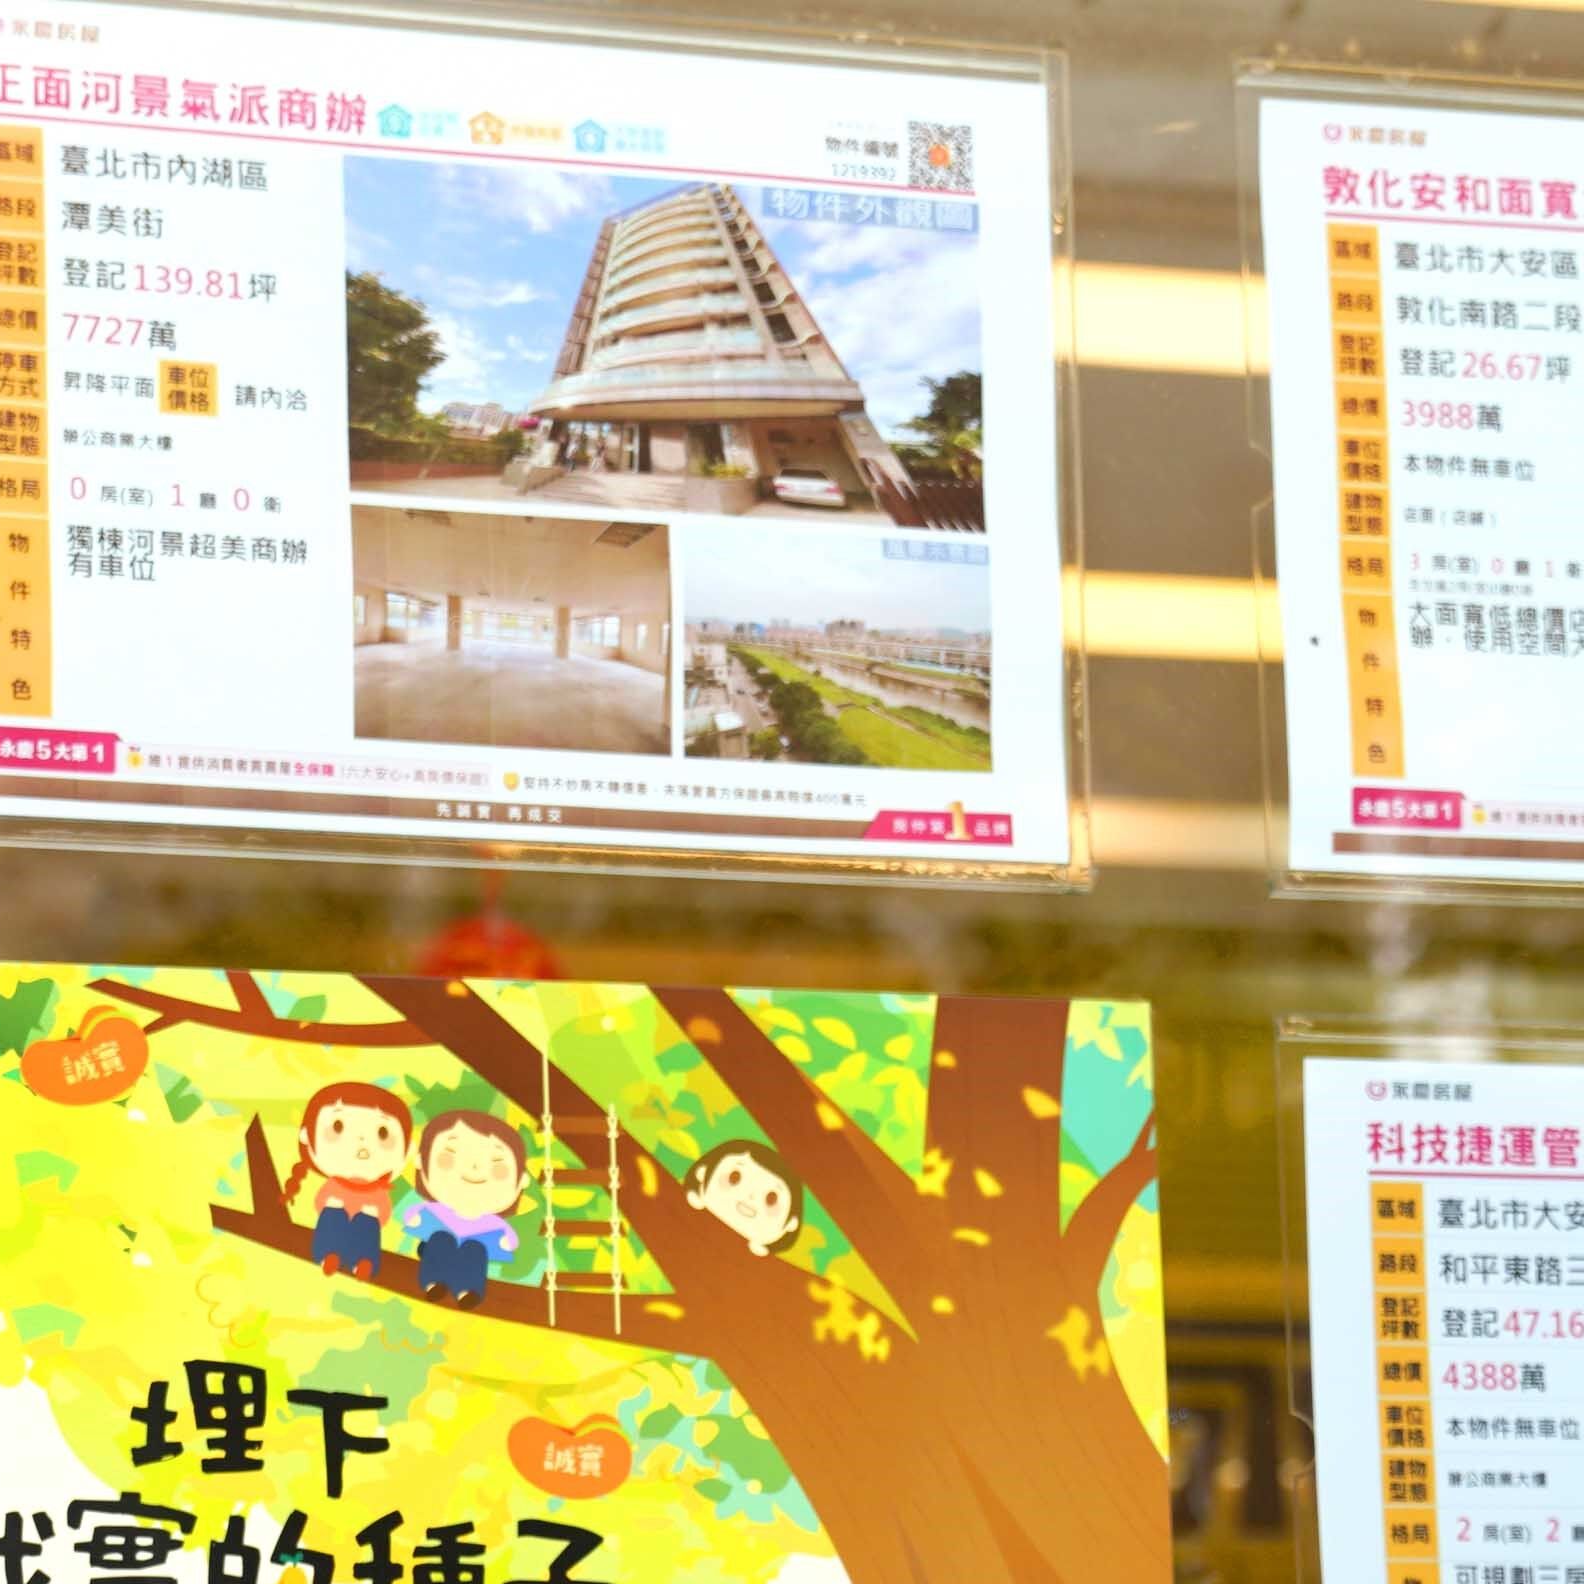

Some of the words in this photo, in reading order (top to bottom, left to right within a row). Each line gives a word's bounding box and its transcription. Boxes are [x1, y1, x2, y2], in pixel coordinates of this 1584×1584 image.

[61, 145, 268, 191] 臺北市內湖區
[62, 202, 163, 239] 潭美街
[1395, 241, 1578, 278] 臺北市大安區
[63, 257, 278, 303] 登記139.81坪
[1396, 296, 1582, 333] 敦化南路二段
[62, 313, 176, 351] 7727萬
[167, 367, 208, 387] 車位
[1401, 348, 1572, 383] 登記26.67坪
[64, 371, 154, 399] 昇降平面
[235, 384, 307, 412] 請內洽
[1401, 400, 1503, 432] 3988萬
[1404, 454, 1535, 482] 本物件無車位
[67, 525, 307, 564] 獨棟河景超美商辦
[69, 552, 155, 581] 有車位
[62, 1041, 125, 1083] 誠實
[1377, 1199, 1416, 1219] 區域
[1379, 1254, 1416, 1273] 路段
[1443, 1362, 1545, 1392] 4388萬
[130, 1360, 389, 1498] 埋下
[1447, 1417, 1580, 1441] 本物件無車位
[544, 1444, 604, 1477] 誠實
[1457, 1517, 1471, 1542] 2
[1546, 1518, 1560, 1542] 2
